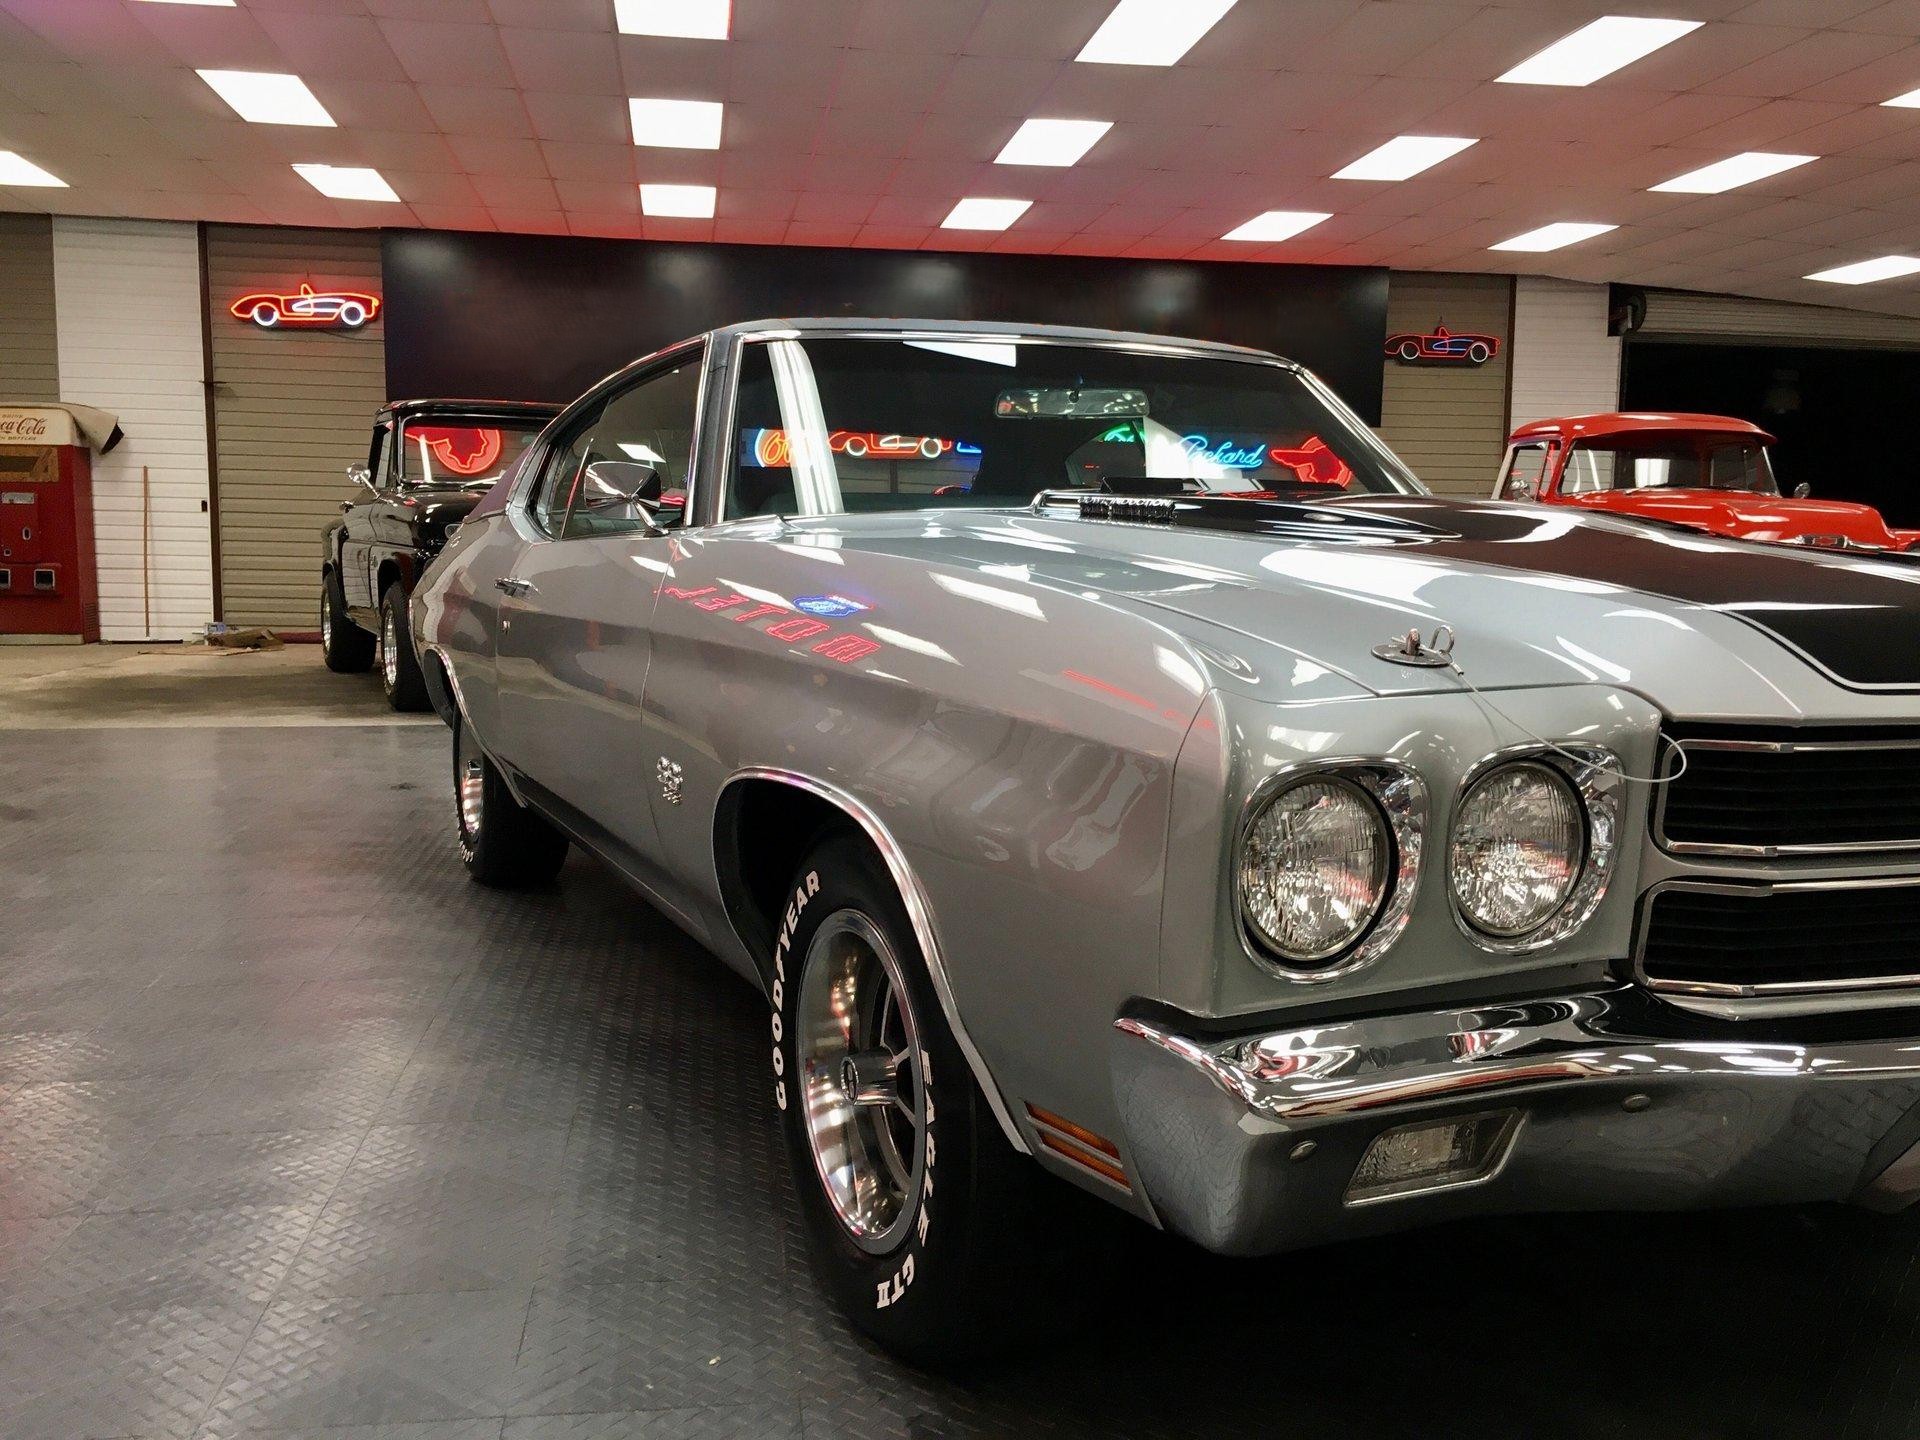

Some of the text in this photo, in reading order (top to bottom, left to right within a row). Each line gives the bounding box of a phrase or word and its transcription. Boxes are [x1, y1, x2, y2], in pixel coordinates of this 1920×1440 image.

[0, 417, 47, 435] ca-Cola
[1178, 435, 1267, 469] Packard
[1109, 498, 1172, 507] INDUCTION
[771, 869, 820, 1111] GOODYEAR
[917, 1050, 936, 1248] EAGLE
